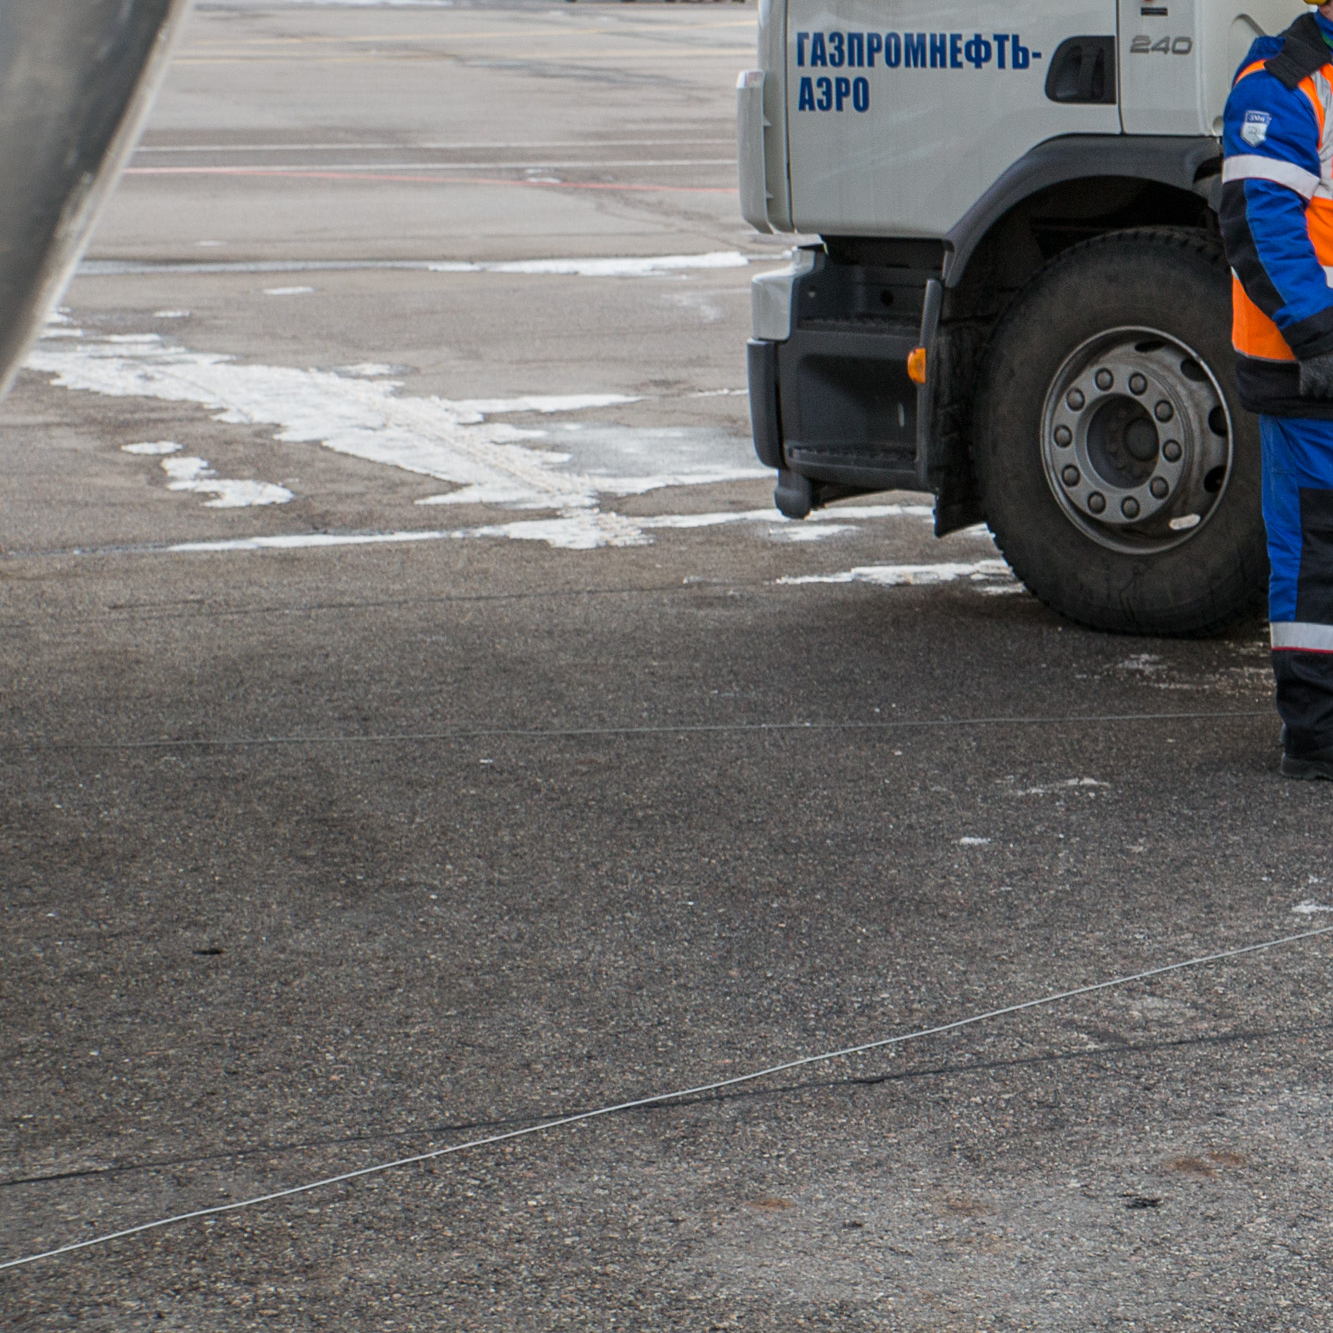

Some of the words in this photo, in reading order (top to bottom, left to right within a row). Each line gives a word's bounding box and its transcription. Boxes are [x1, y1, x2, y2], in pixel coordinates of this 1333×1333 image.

[796, 31, 1043, 71] ГАЗПРОМНЕФТЬ-
[1129, 34, 1194, 56] 240
[798, 75, 871, 114] АЭРО
